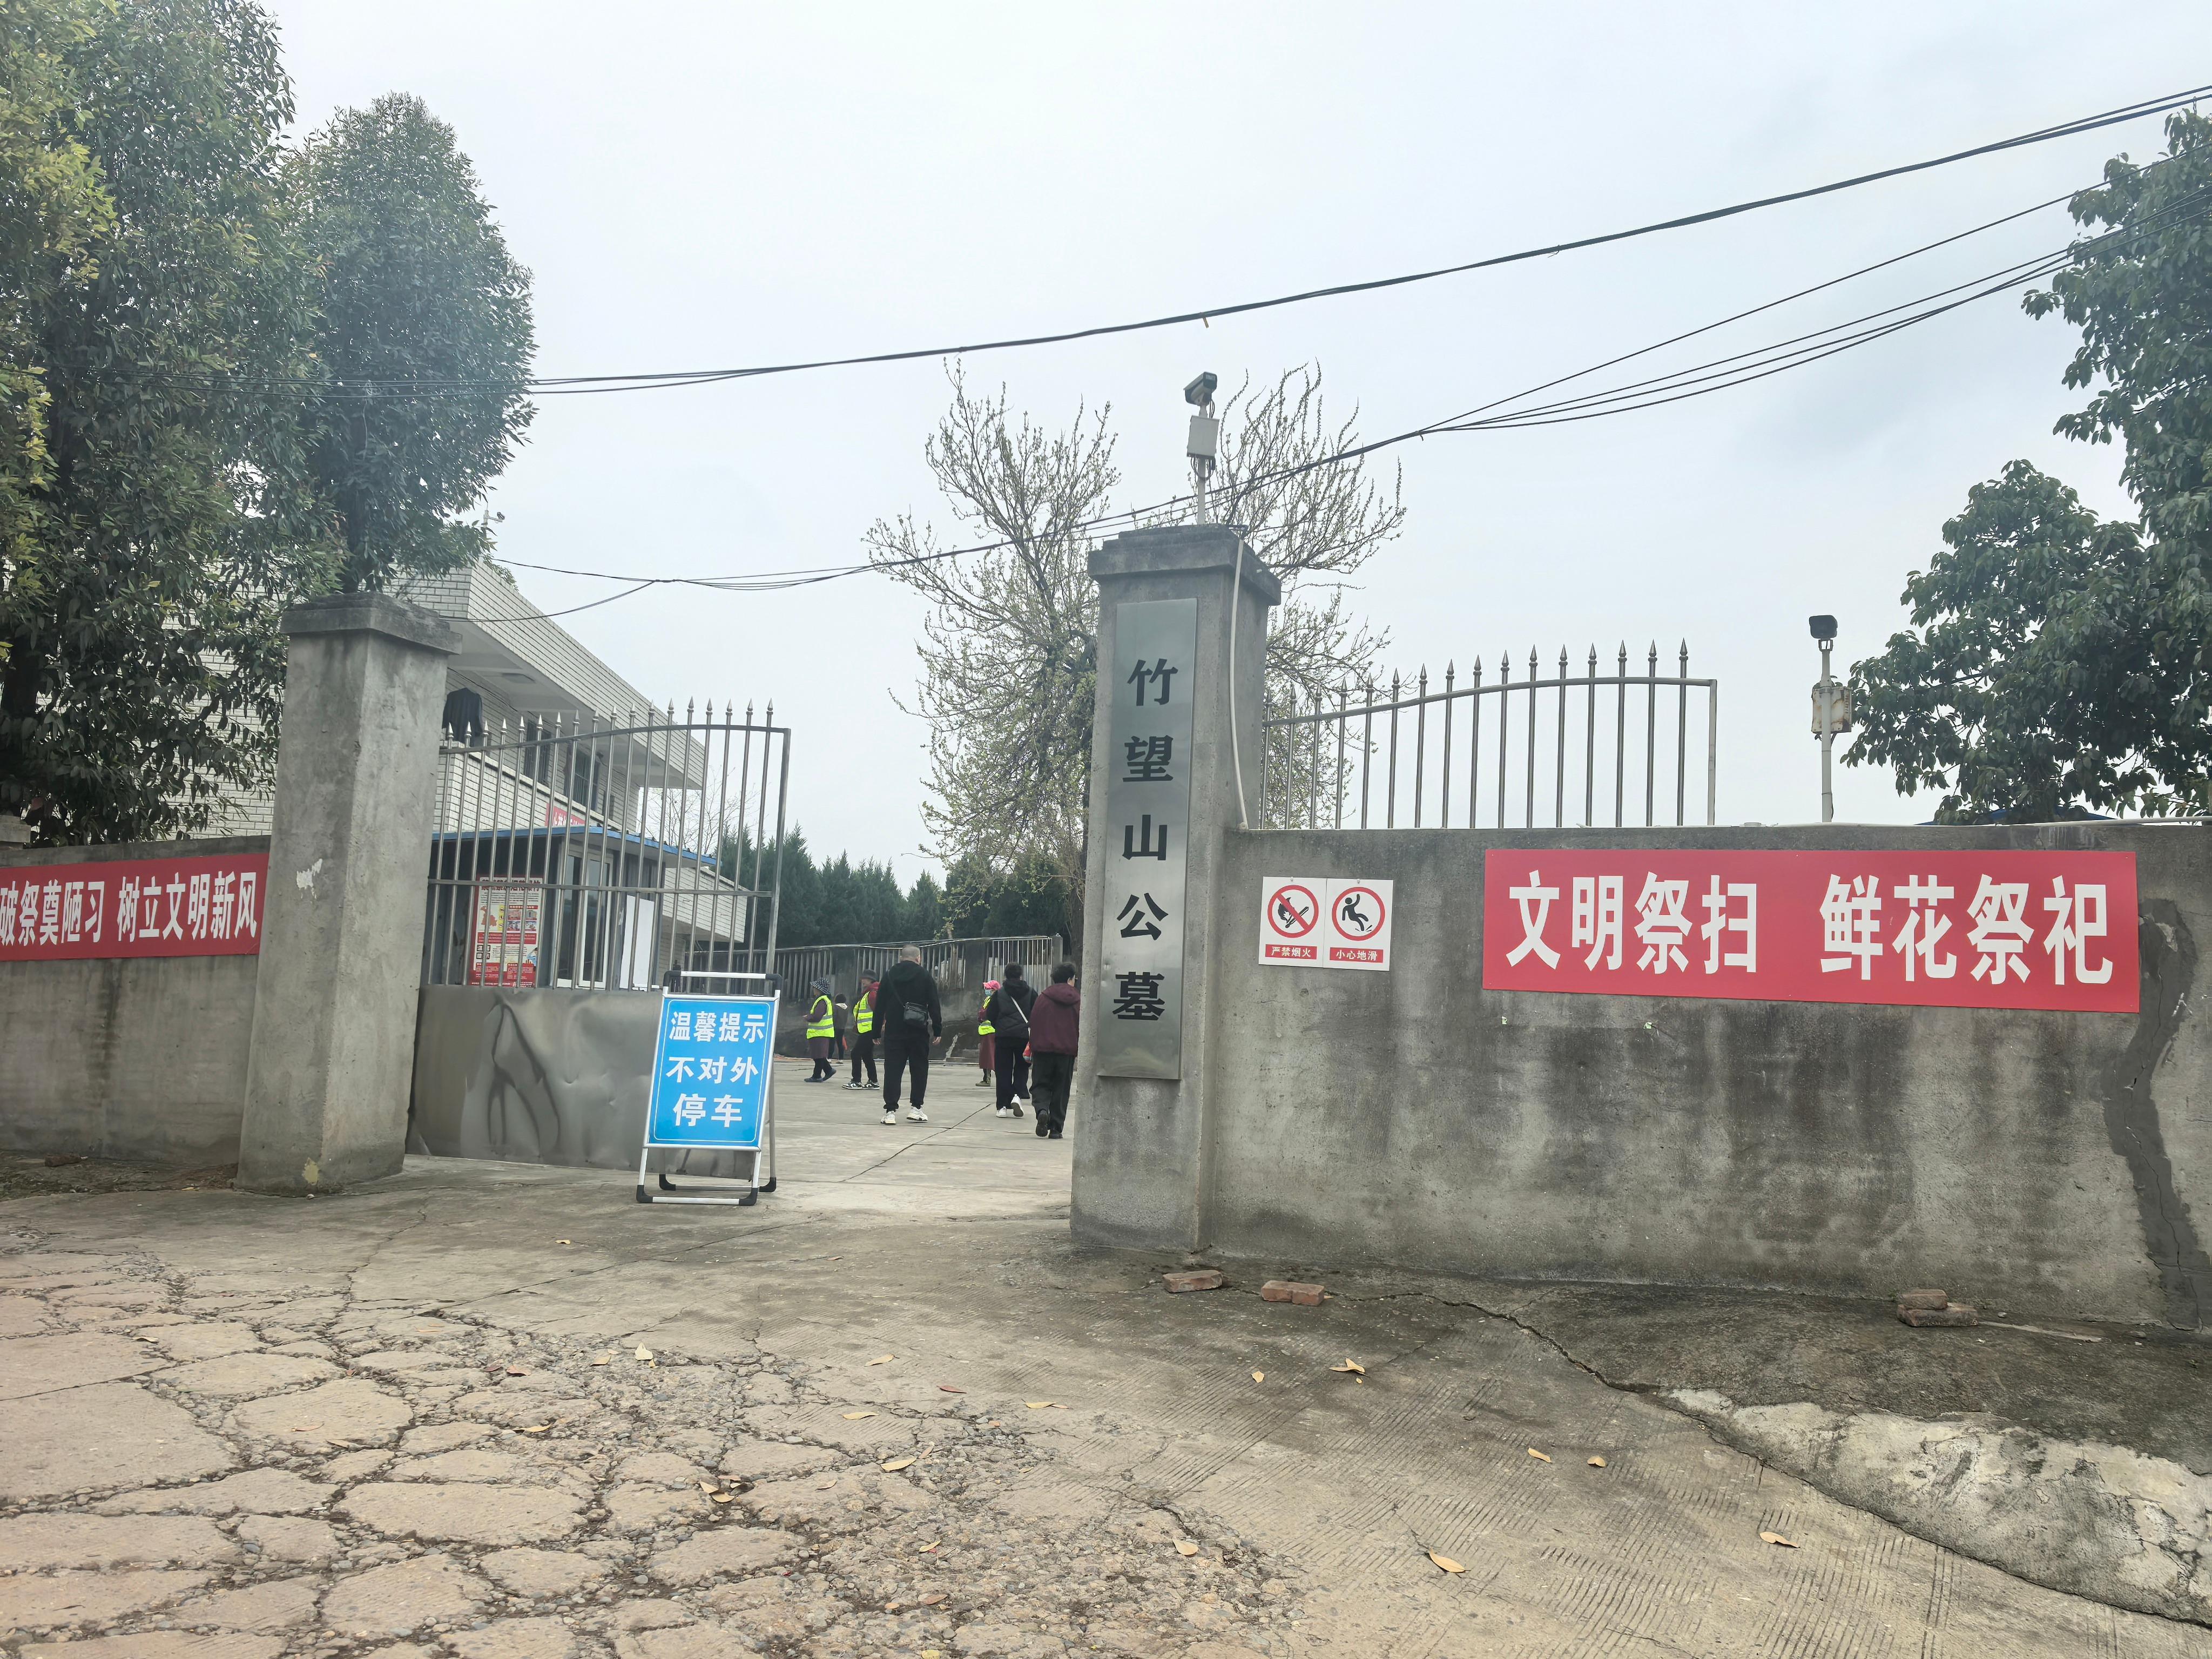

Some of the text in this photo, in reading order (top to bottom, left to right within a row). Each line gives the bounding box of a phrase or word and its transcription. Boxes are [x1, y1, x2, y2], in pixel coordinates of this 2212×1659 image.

[1112, 658, 1178, 1021] 竹望山公墓
[0, 871, 257, 946] 破祭奠陋习 树立文明新风
[1506, 869, 2113, 986] 文明祭扫 鲜花祭祀
[1271, 946, 1311, 957] 严禁烟火
[1336, 950, 1378, 961] 小心地滑
[669, 1011, 765, 1043] 温馨提示
[666, 1056, 759, 1084] 不对外
[673, 1093, 743, 1128] 停车
